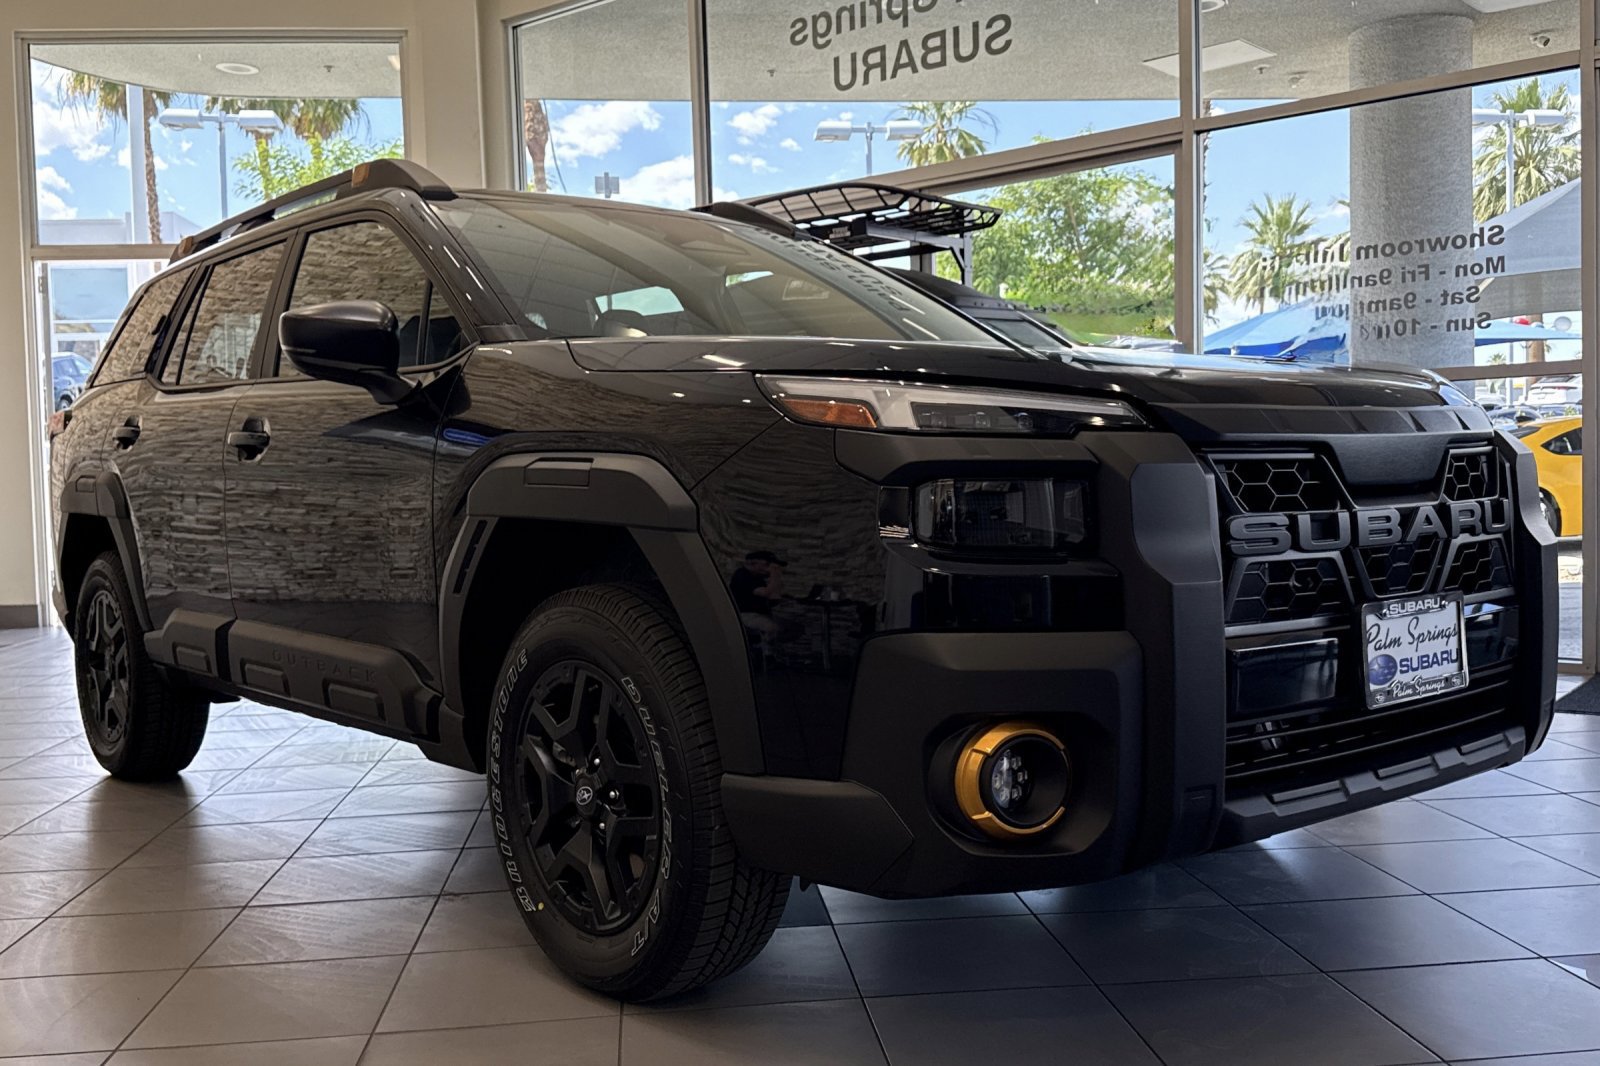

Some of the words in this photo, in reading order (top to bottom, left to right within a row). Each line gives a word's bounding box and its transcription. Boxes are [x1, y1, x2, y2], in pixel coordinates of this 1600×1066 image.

[1228, 498, 1510, 556] SUBARU
[1389, 598, 1440, 615] SUBARU
[1367, 623, 1402, 651] Palm
[1407, 616, 1458, 653] Springs
[1399, 648, 1459, 674] SUBARU
[1393, 683, 1413, 697] Palm
[1415, 678, 1445, 696] Springs
[490, 648, 537, 911] BRIDGESTONE
[621, 676, 672, 880] DUELER
